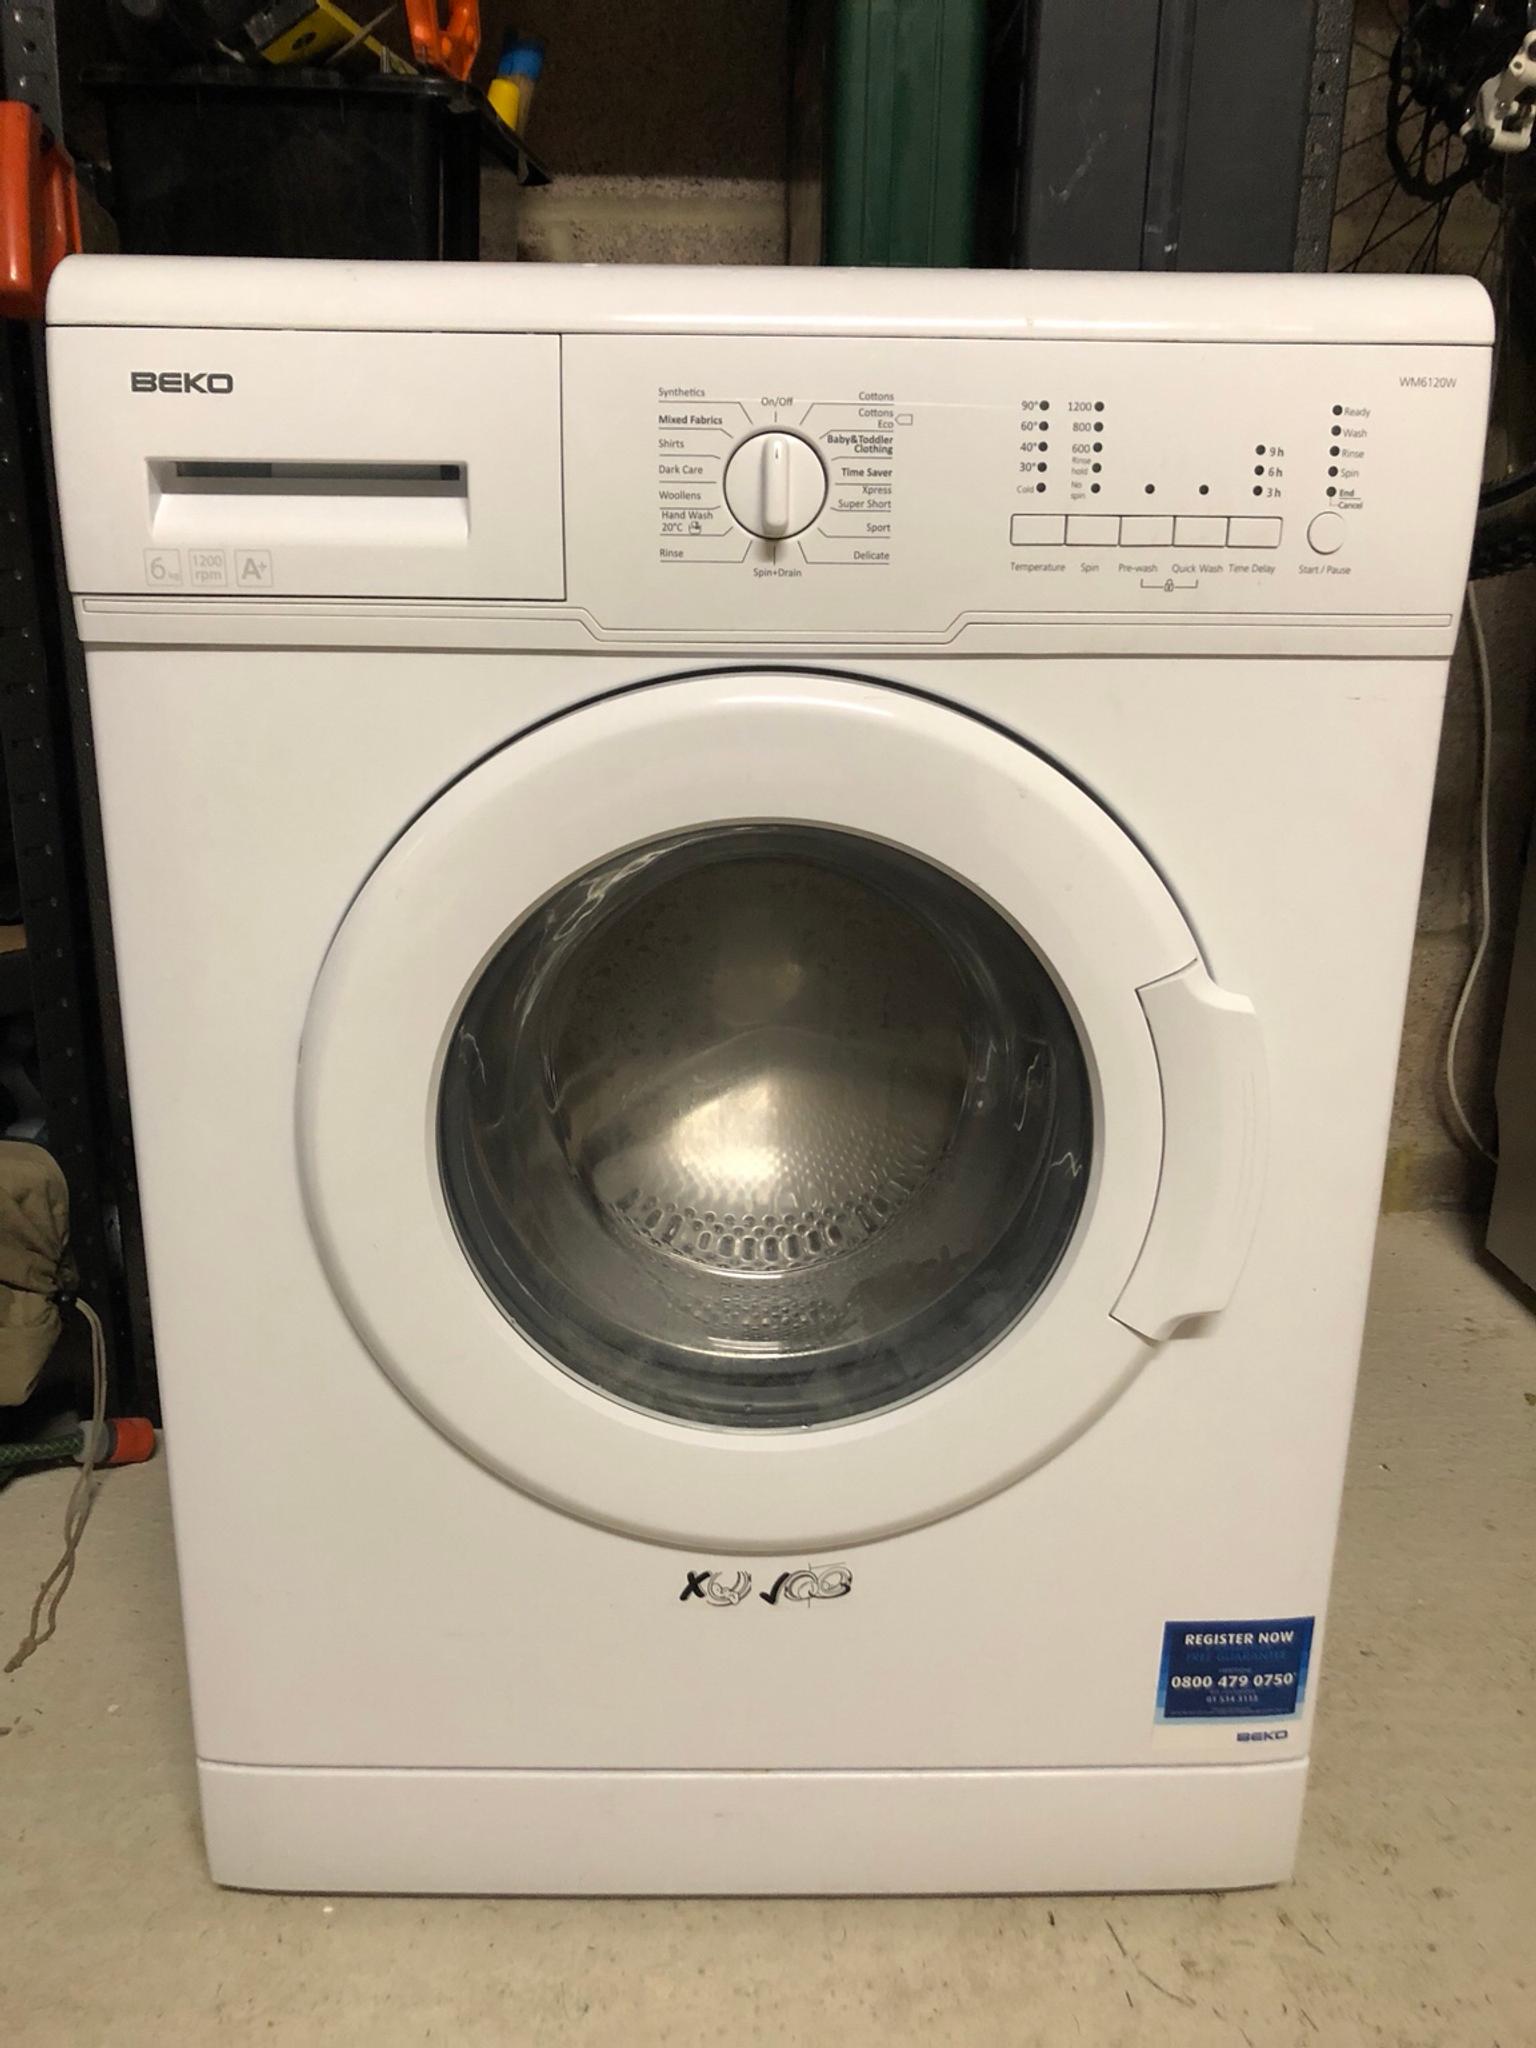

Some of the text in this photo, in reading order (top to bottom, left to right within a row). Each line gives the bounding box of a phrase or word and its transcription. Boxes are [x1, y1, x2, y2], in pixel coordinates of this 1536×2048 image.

[130, 371, 234, 394] BEKO
[1399, 377, 1457, 388] WM6120W
[658, 387, 706, 398] Synthetics
[858, 392, 894, 401] Cottons
[761, 397, 793, 407] On/Off
[1068, 402, 1092, 412] 1200
[858, 408, 894, 417] Cottons
[1344, 407, 1371, 418] Ready
[658, 415, 723, 425] Mixed Fabrics
[877, 420, 894, 428] Eco
[1072, 422, 1091, 432] 800
[1343, 429, 1367, 438] Wash
[658, 439, 684, 448] Shirts
[827, 435, 893, 446] Baby&Toddler
[854, 444, 893, 455] Clothing
[1072, 444, 1090, 453] 600
[1269, 447, 1284, 457] 9 h
[1342, 449, 1364, 458] Rinse
[658, 465, 703, 475] Dark Care
[841, 468, 893, 477] Time Saver
[1268, 467, 1283, 477] 6 h
[1341, 468, 1359, 479] Spin
[862, 486, 892, 496] Xpress
[1016, 485, 1034, 494] Cold
[1266, 488, 1281, 498] 3 h
[1339, 488, 1354, 497] End
[659, 490, 701, 500] Woollens
[838, 500, 891, 510] Super Short
[1338, 501, 1363, 510] Cancel
[662, 511, 713, 520] Hand Wash
[866, 523, 890, 533] Sport
[659, 549, 684, 558] Rinse
[853, 551, 890, 560] Delicate
[192, 555, 223, 568] 1200
[149, 556, 166, 580] 6
[753, 568, 802, 578] Spin+Drain
[1011, 562, 1066, 574] Temperature
[1081, 562, 1099, 574] Spin
[1118, 563, 1158, 573] Pre-wash
[1171, 564, 1223, 574] Quick Wash
[1228, 563, 1276, 575] Time Delay
[1298, 565, 1320, 574] Start
[1326, 565, 1351, 575] Pause
[195, 569, 222, 582] rpm
[1185, 1630, 1294, 1646] REGISTER NOW
[1171, 1675, 1213, 1689] 0800
[1217, 1675, 1249, 1688] 479
[1236, 1730, 1288, 1742] BEKO
